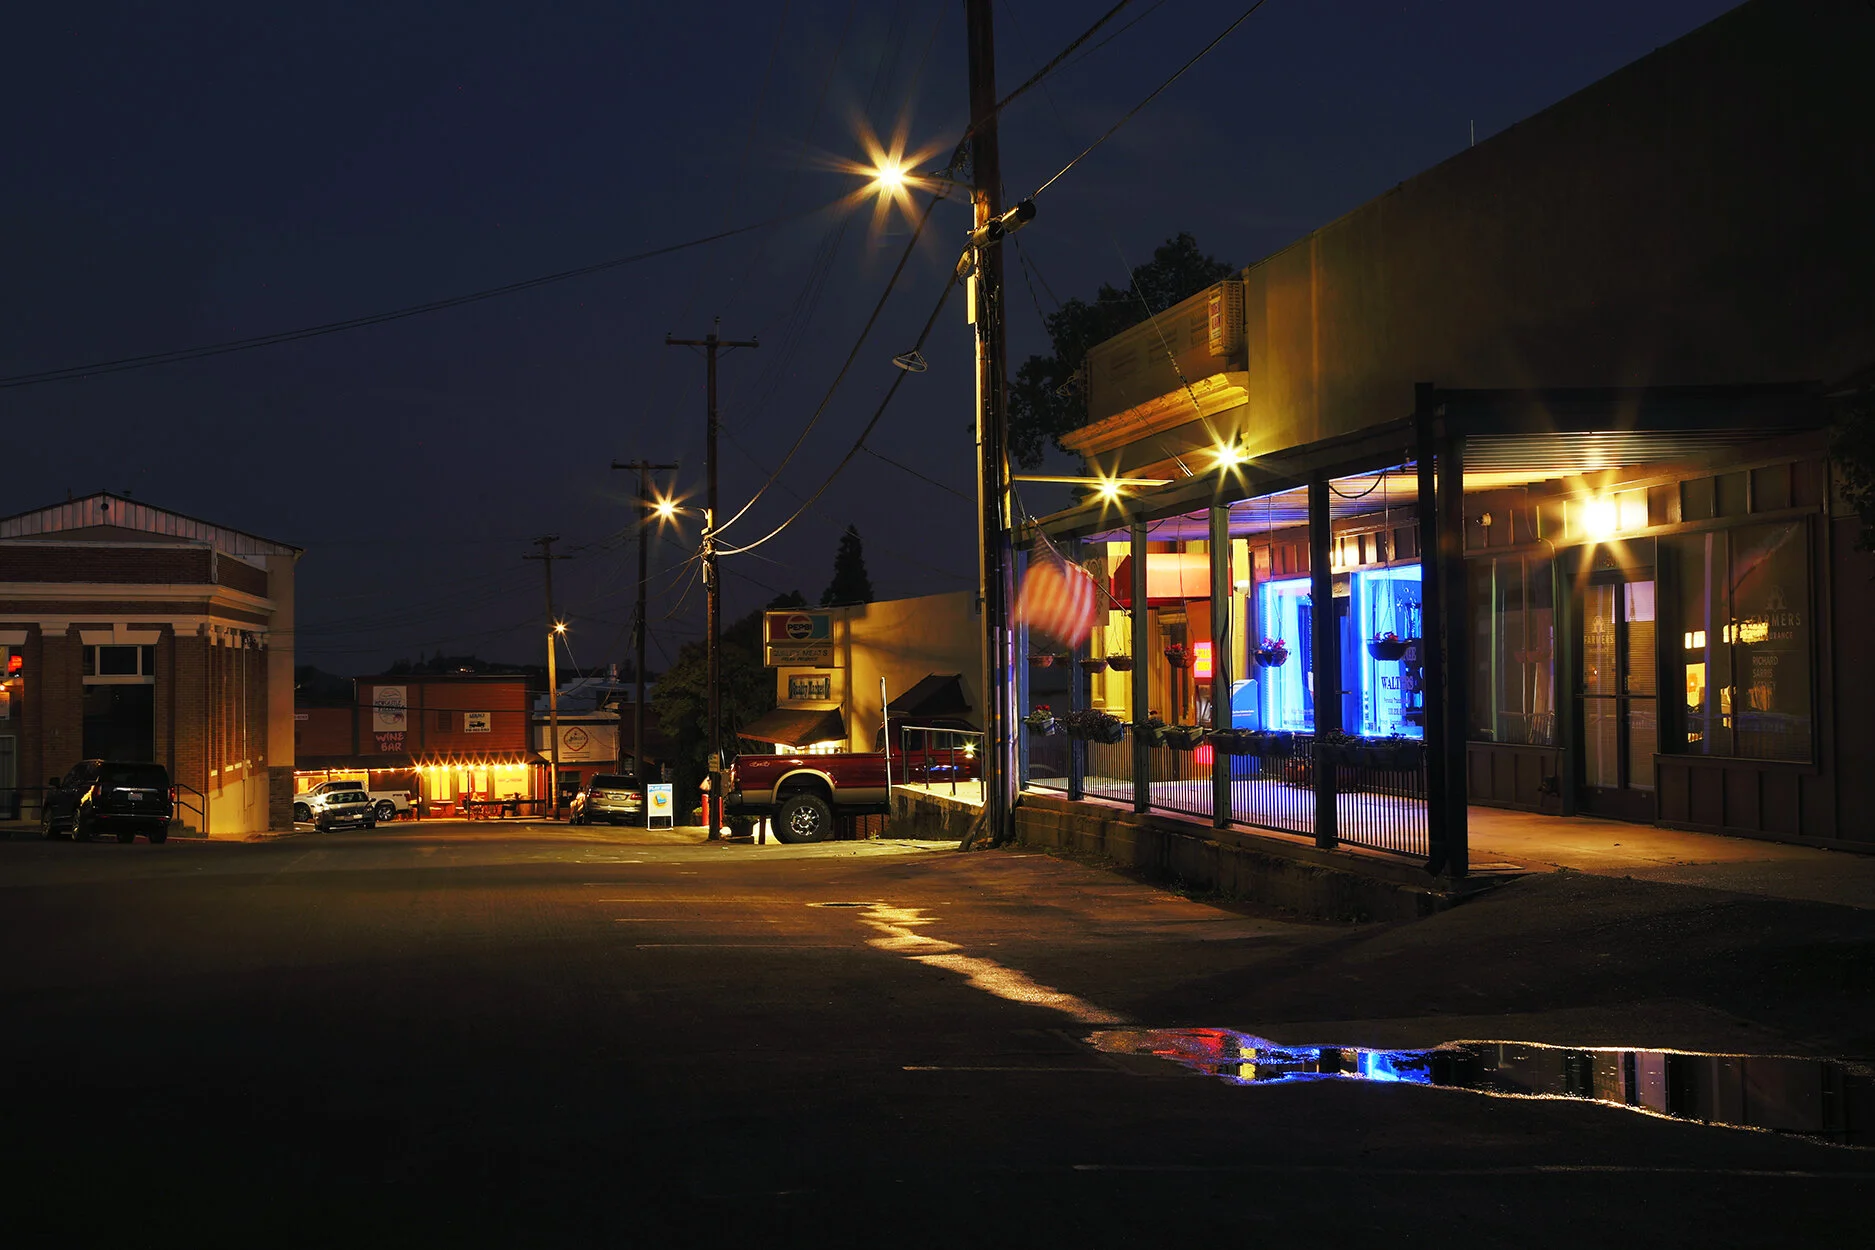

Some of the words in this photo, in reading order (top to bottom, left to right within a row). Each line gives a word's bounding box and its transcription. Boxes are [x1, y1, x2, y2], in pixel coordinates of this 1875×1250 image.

[1751, 612, 1801, 627] FARMERS
[787, 623, 812, 631] PEPSI
[1584, 635, 1614, 644] FARMERS
[1752, 656, 1779, 666] RICHARD
[375, 732, 404, 742] WINE
[380, 742, 402, 752] BAR
